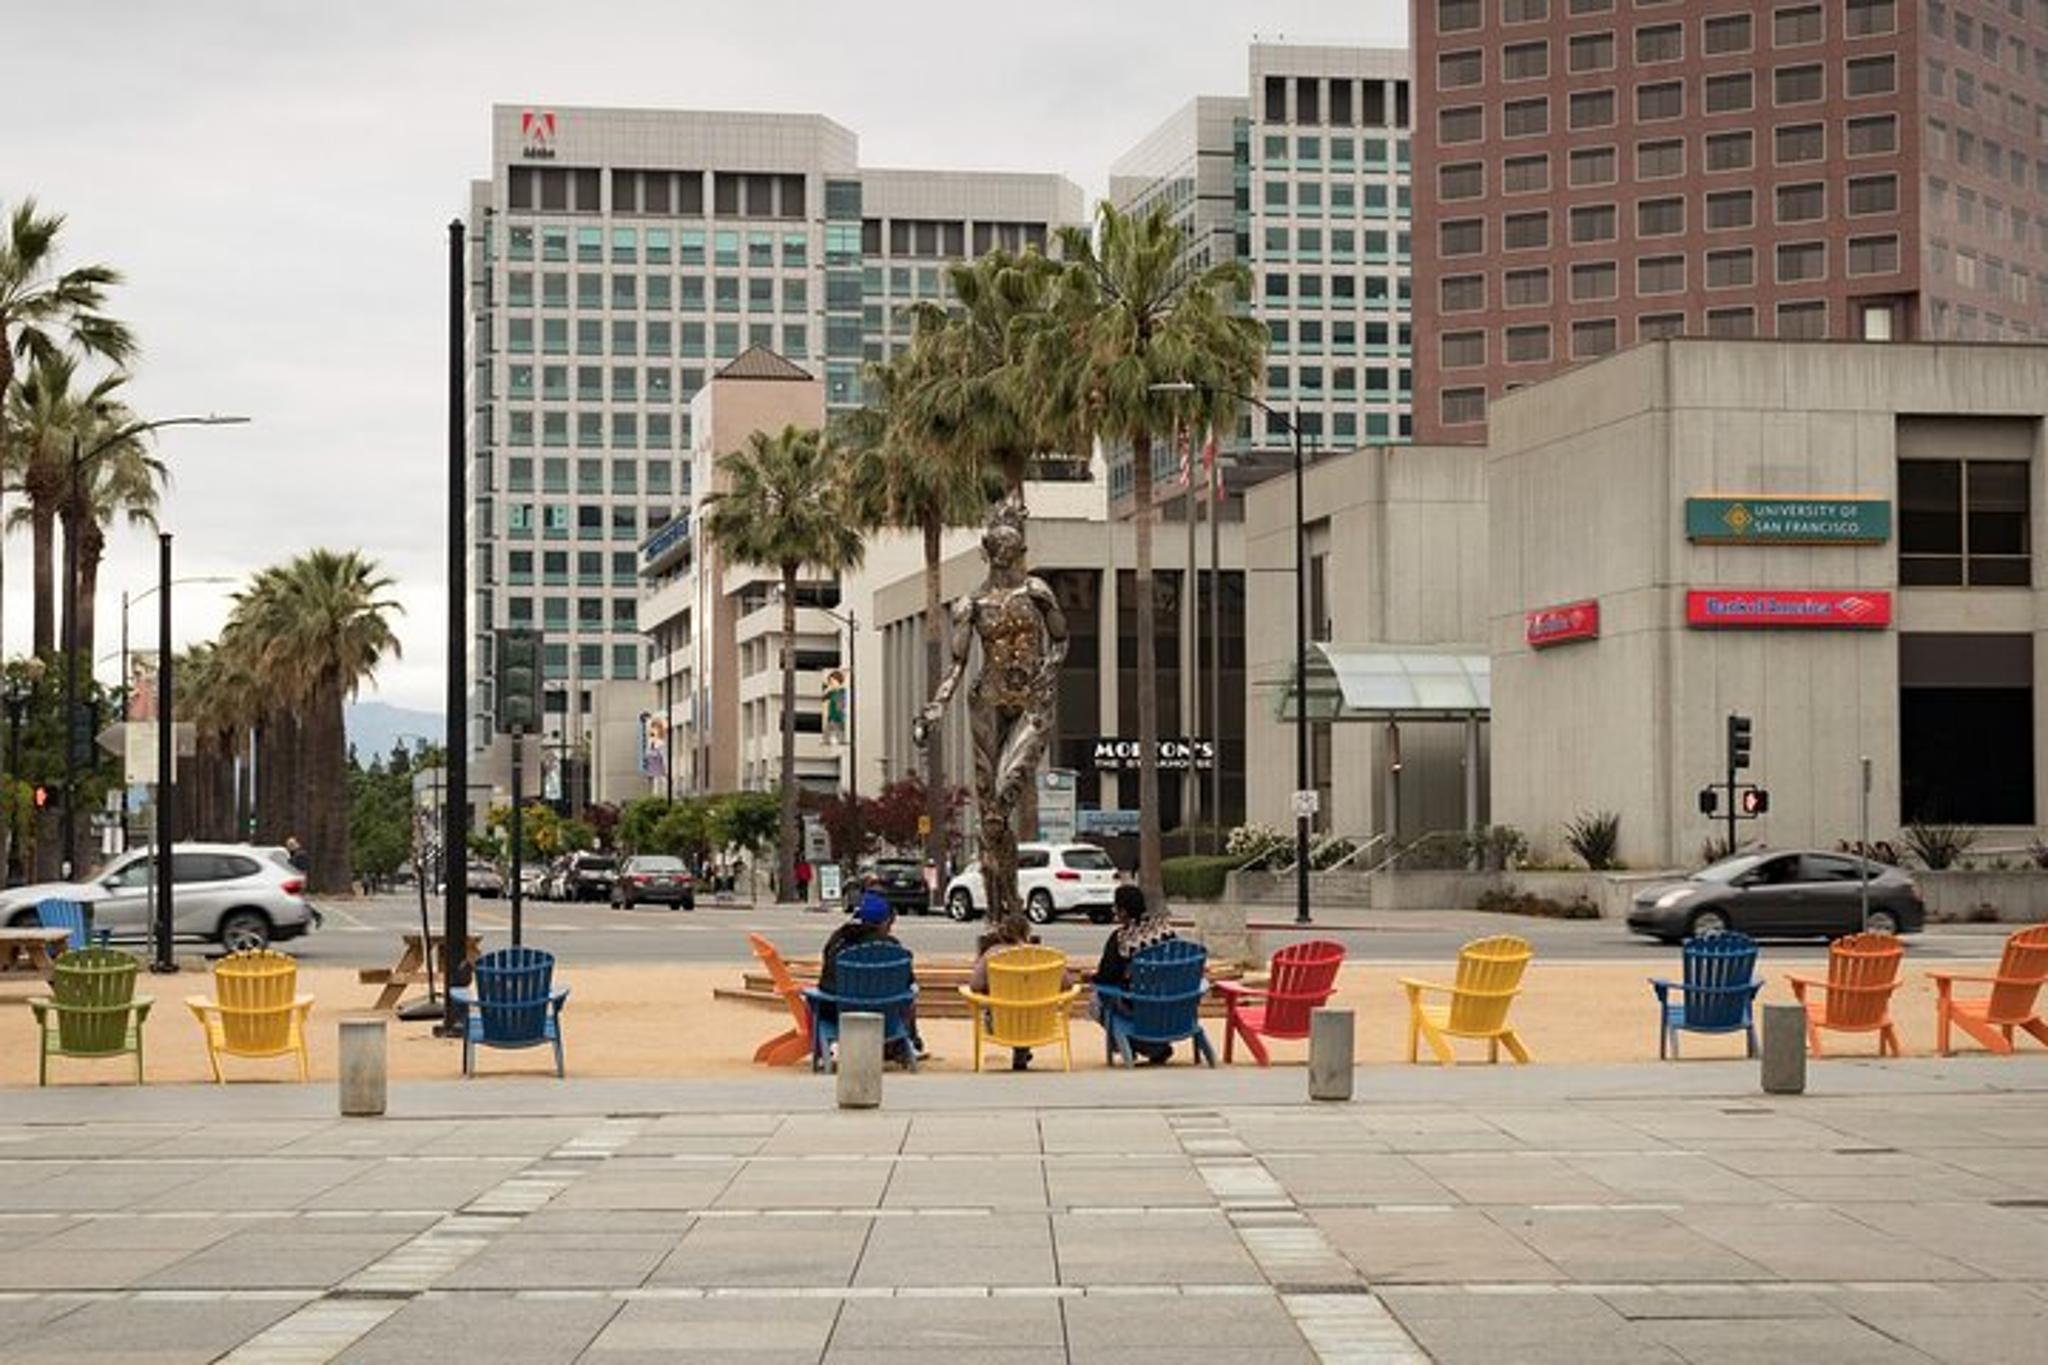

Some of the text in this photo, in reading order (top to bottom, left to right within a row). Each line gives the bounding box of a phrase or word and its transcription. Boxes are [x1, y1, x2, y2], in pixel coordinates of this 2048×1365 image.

[1754, 505, 1858, 518] UNIVERSITY OF
[1754, 521, 1860, 534] SAN FRANCISCO
[1094, 742, 1213, 757] MOON'S
